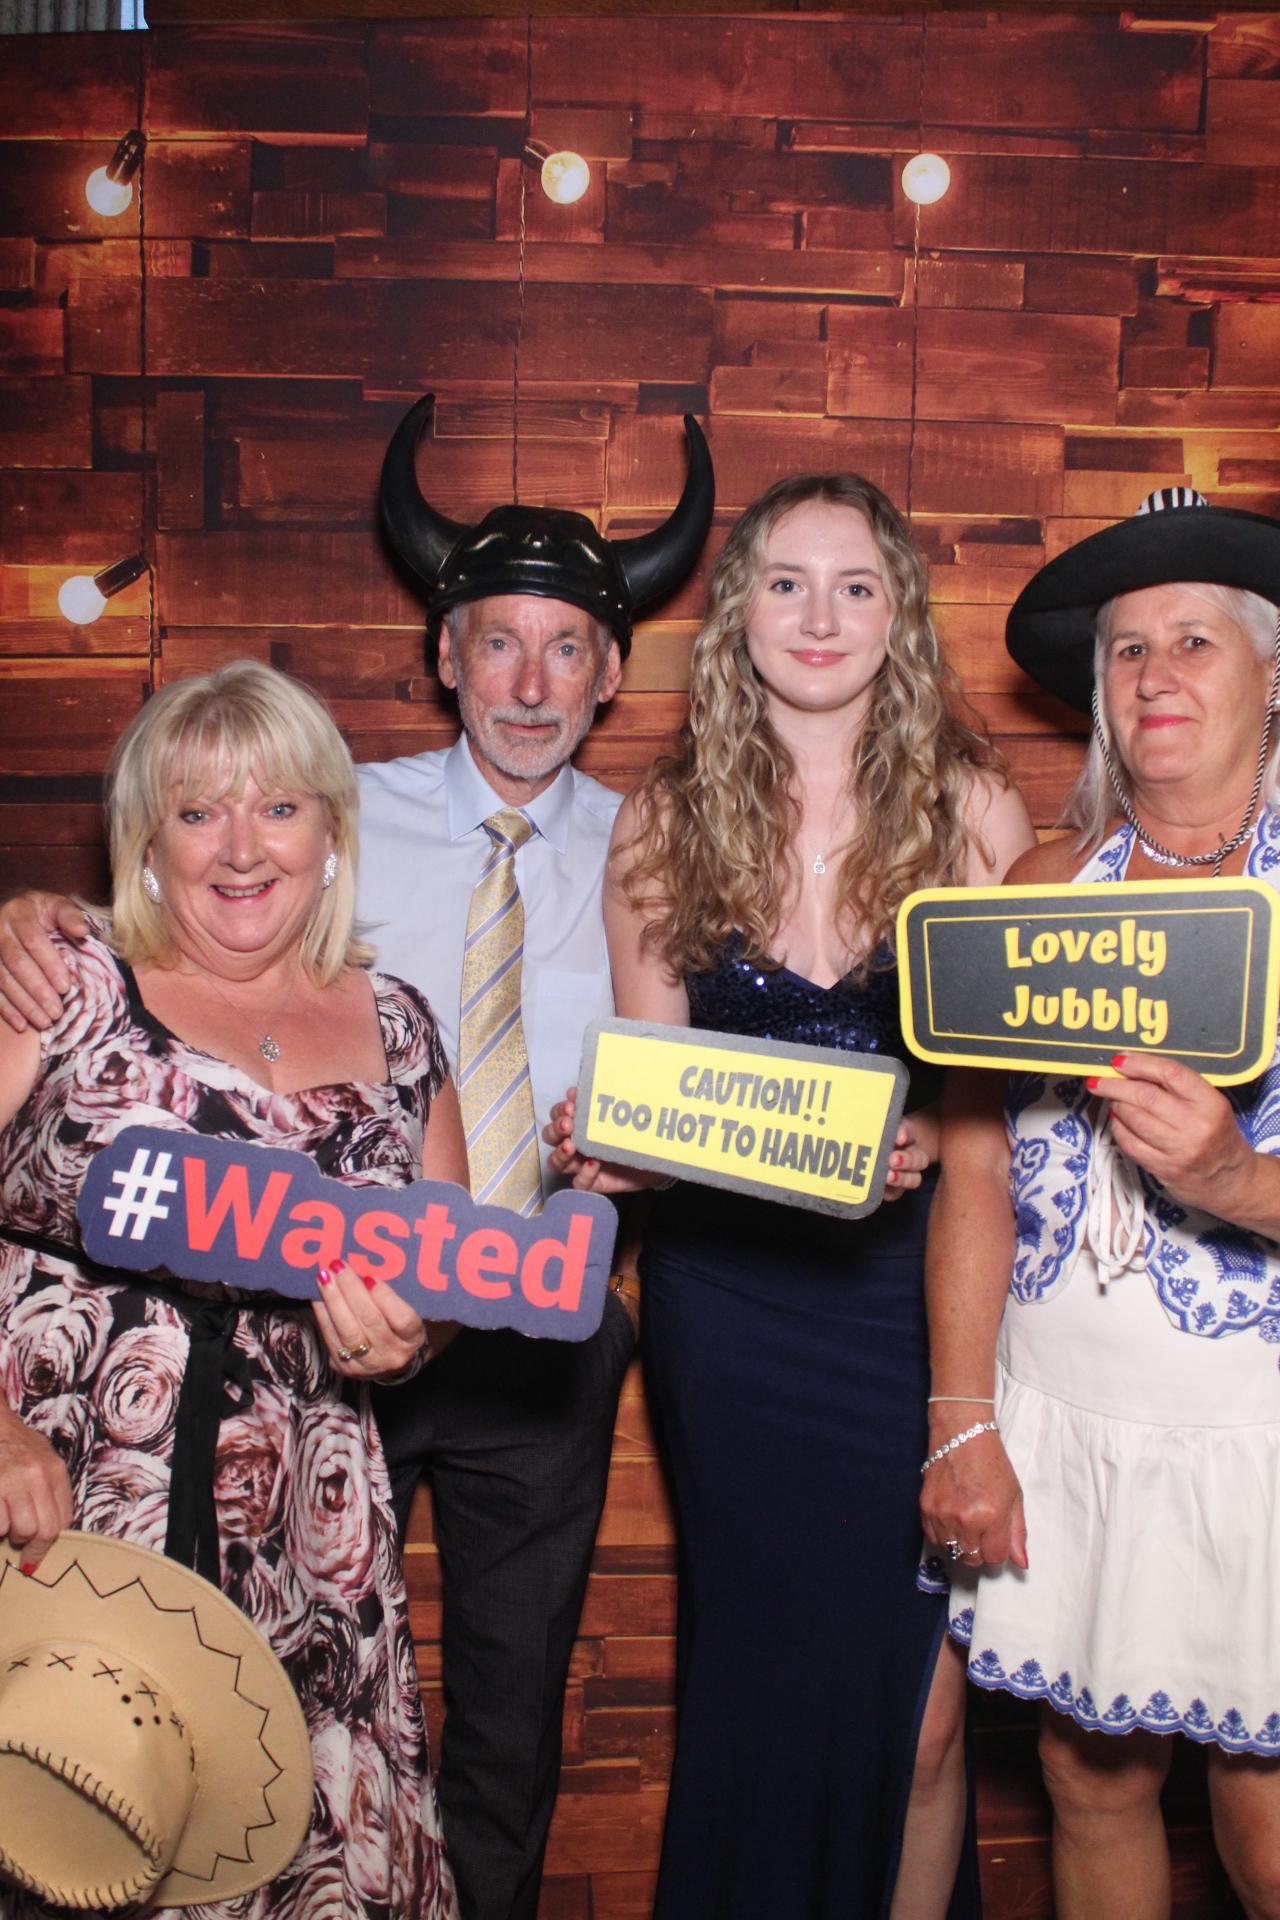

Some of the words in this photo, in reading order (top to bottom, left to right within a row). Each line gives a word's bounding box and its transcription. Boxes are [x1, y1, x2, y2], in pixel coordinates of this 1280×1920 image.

[1004, 919, 1167, 977] Lovely
[1002, 985, 1168, 1045] Jubbly
[679, 1065, 832, 1126] CAUTION!!
[597, 1094, 652, 1132] TOO
[656, 1107, 715, 1148] HOT
[720, 1119, 756, 1157] TO
[758, 1127, 872, 1187] HANDLE
[102, 1148, 594, 1313] #Wasted
